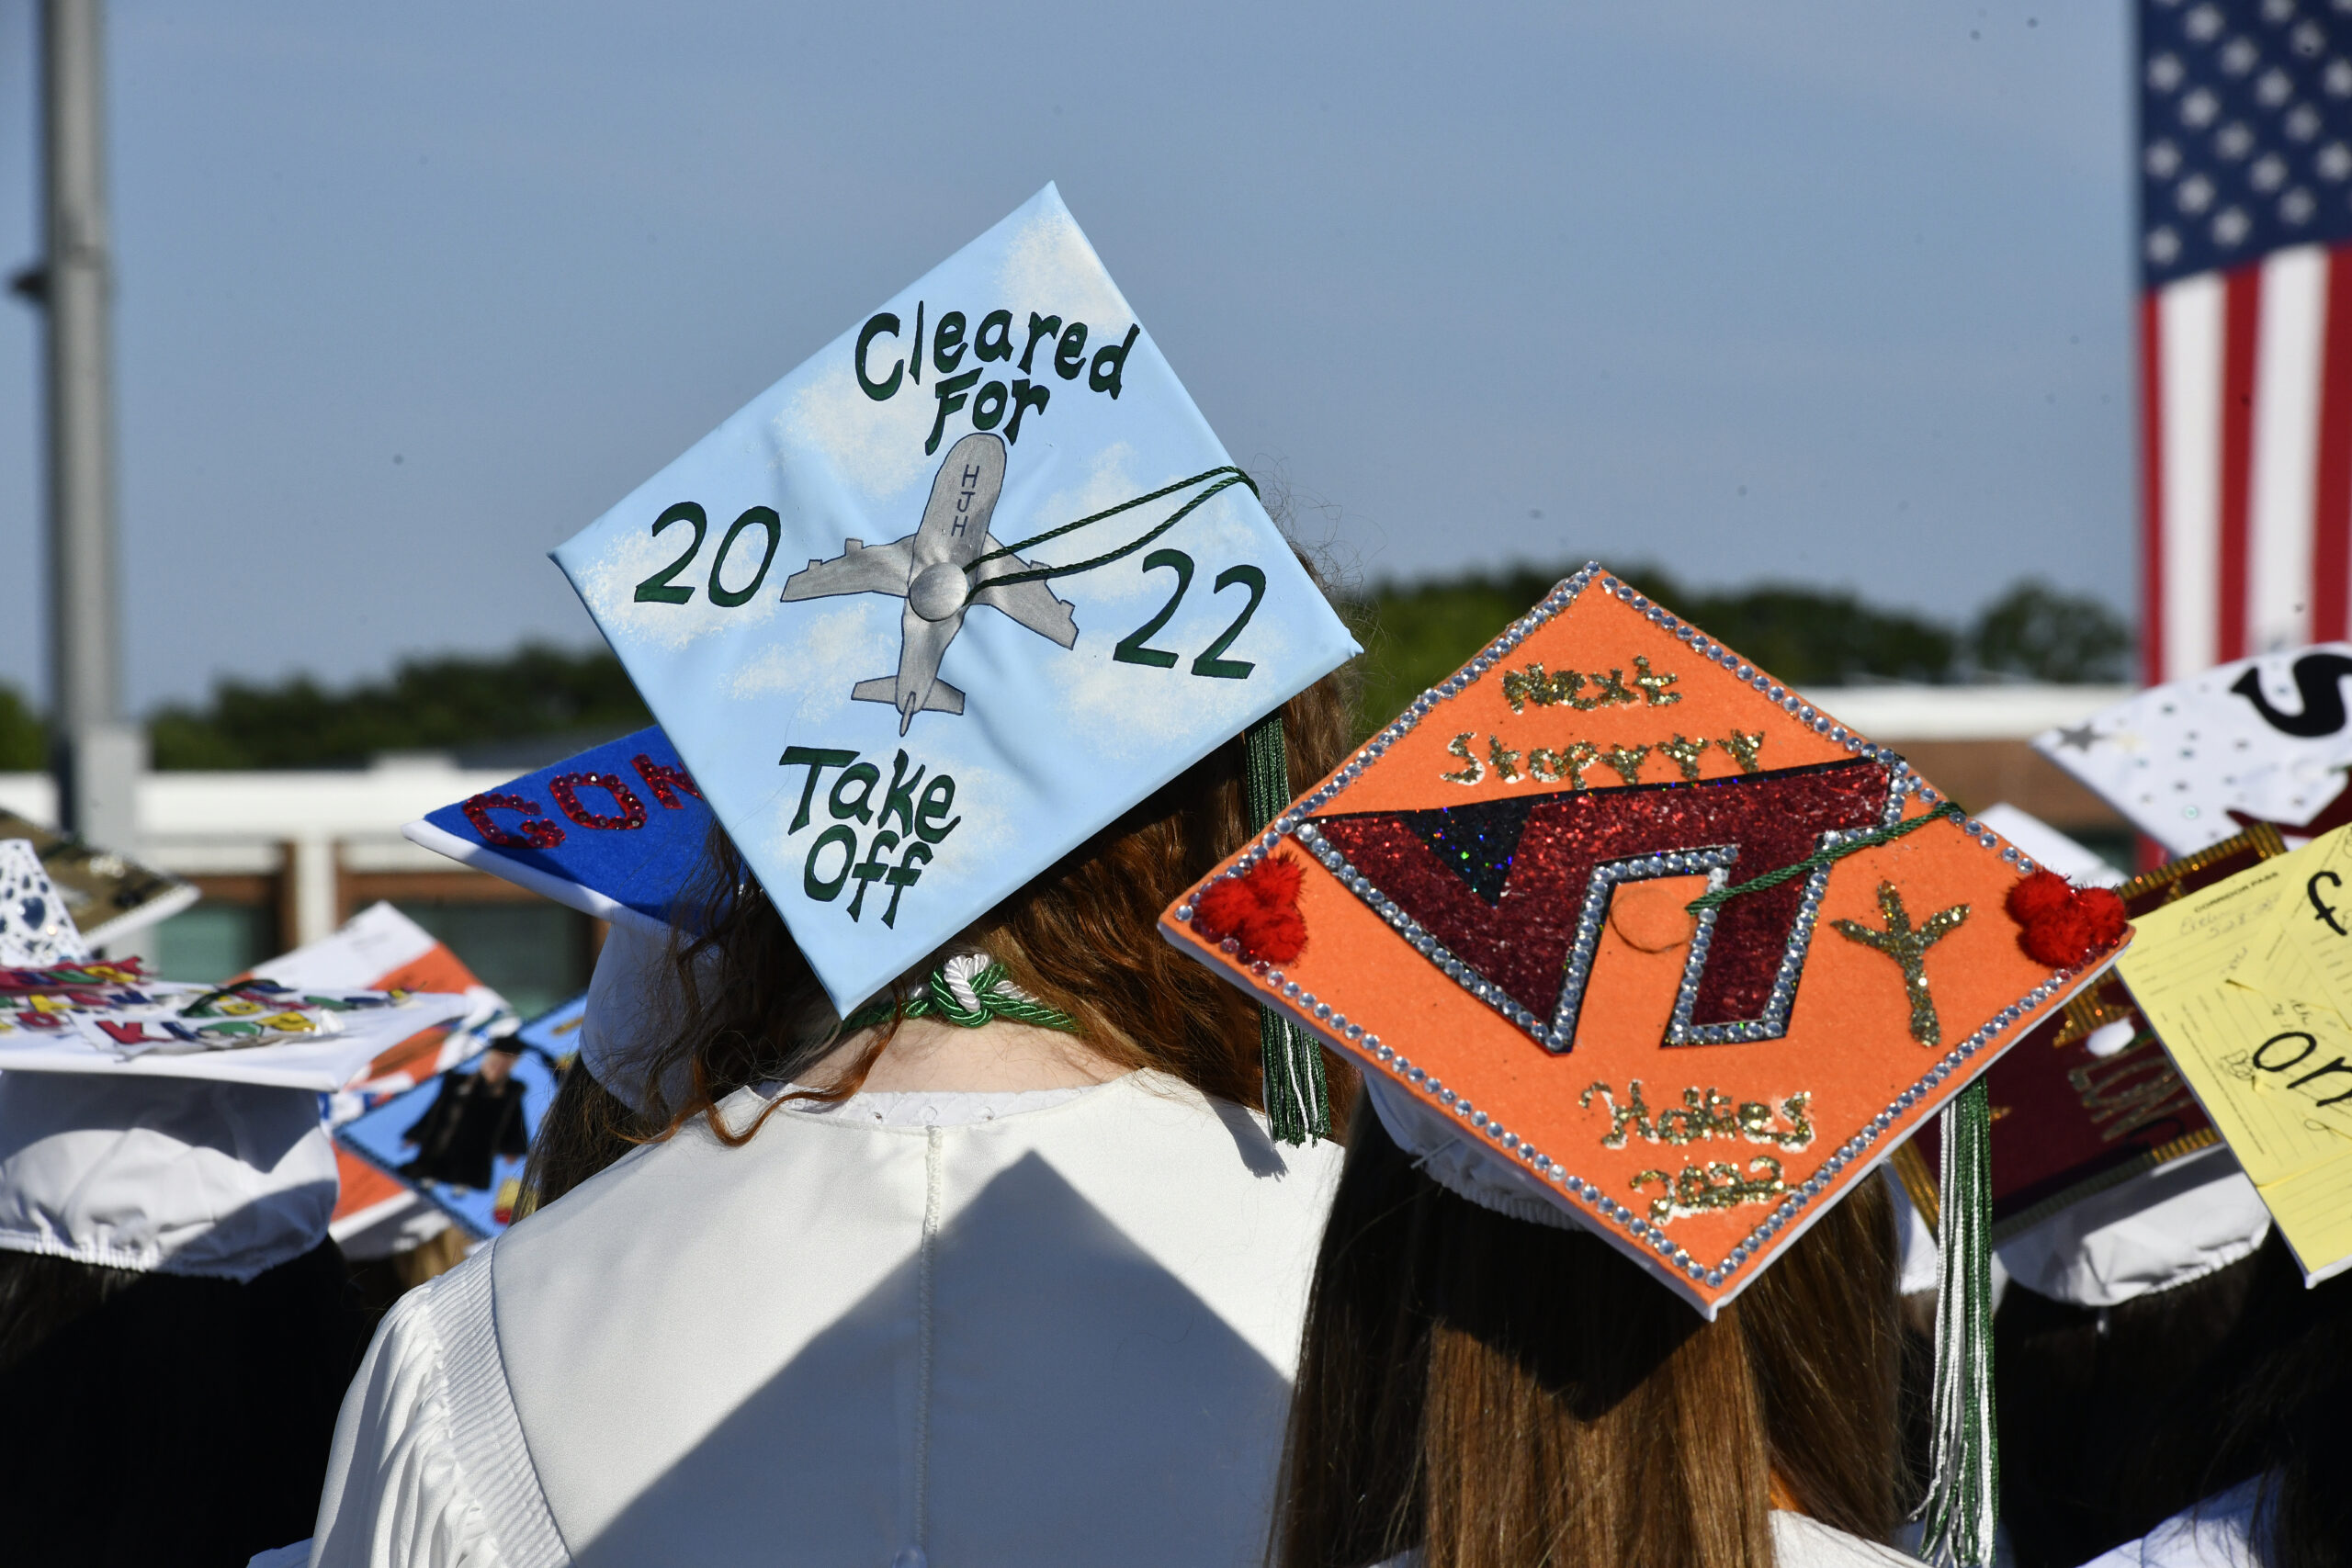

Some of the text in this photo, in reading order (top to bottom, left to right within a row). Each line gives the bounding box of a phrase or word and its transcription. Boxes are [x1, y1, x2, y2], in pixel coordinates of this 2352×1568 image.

[854, 300, 1141, 401] Cleared
[924, 367, 1051, 457] For
[633, 501, 1267, 680] 20 22
[1502, 654, 1683, 714] Next
[778, 745, 961, 845] Take
[803, 823, 933, 930] Off
